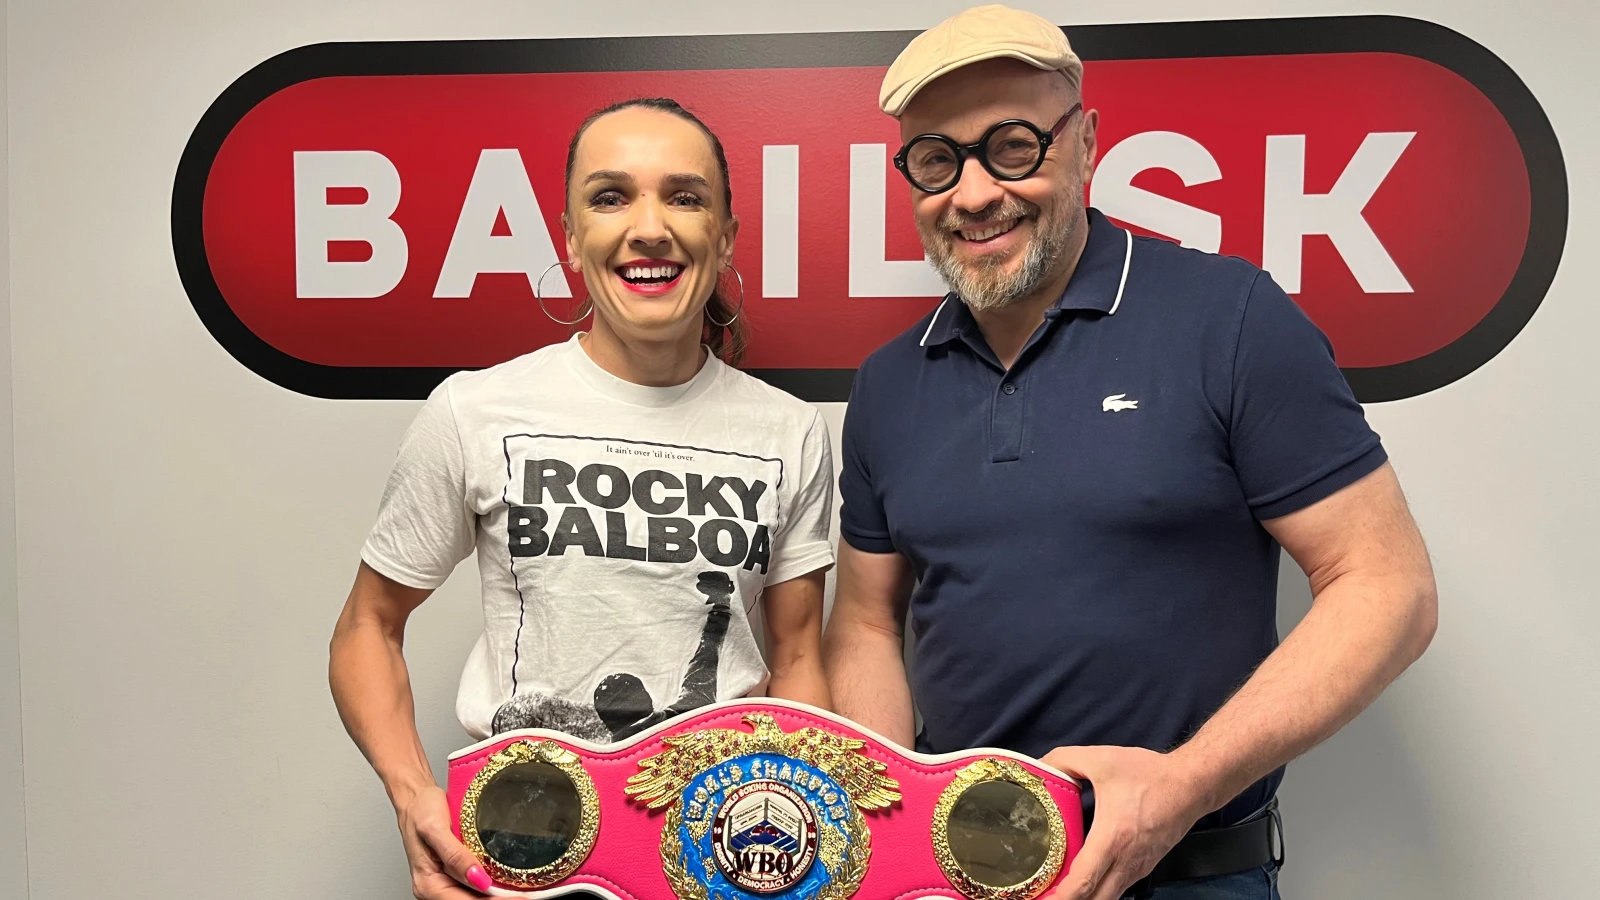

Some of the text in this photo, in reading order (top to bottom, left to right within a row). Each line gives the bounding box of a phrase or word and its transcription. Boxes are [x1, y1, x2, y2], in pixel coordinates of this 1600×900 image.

[293, 131, 1418, 299] BAILSK
[606, 445, 695, 462] It ain't over 'til it's over.
[522, 458, 768, 523] ROCKY
[507, 505, 771, 575] BALBOA
[718, 793, 739, 819] WORLD
[739, 783, 768, 798] BOXING
[768, 783, 814, 824] ORGANIZATION
[714, 842, 814, 889] DIGNITY DEMOCRACY HONESTY
[733, 851, 794, 875] WBO
